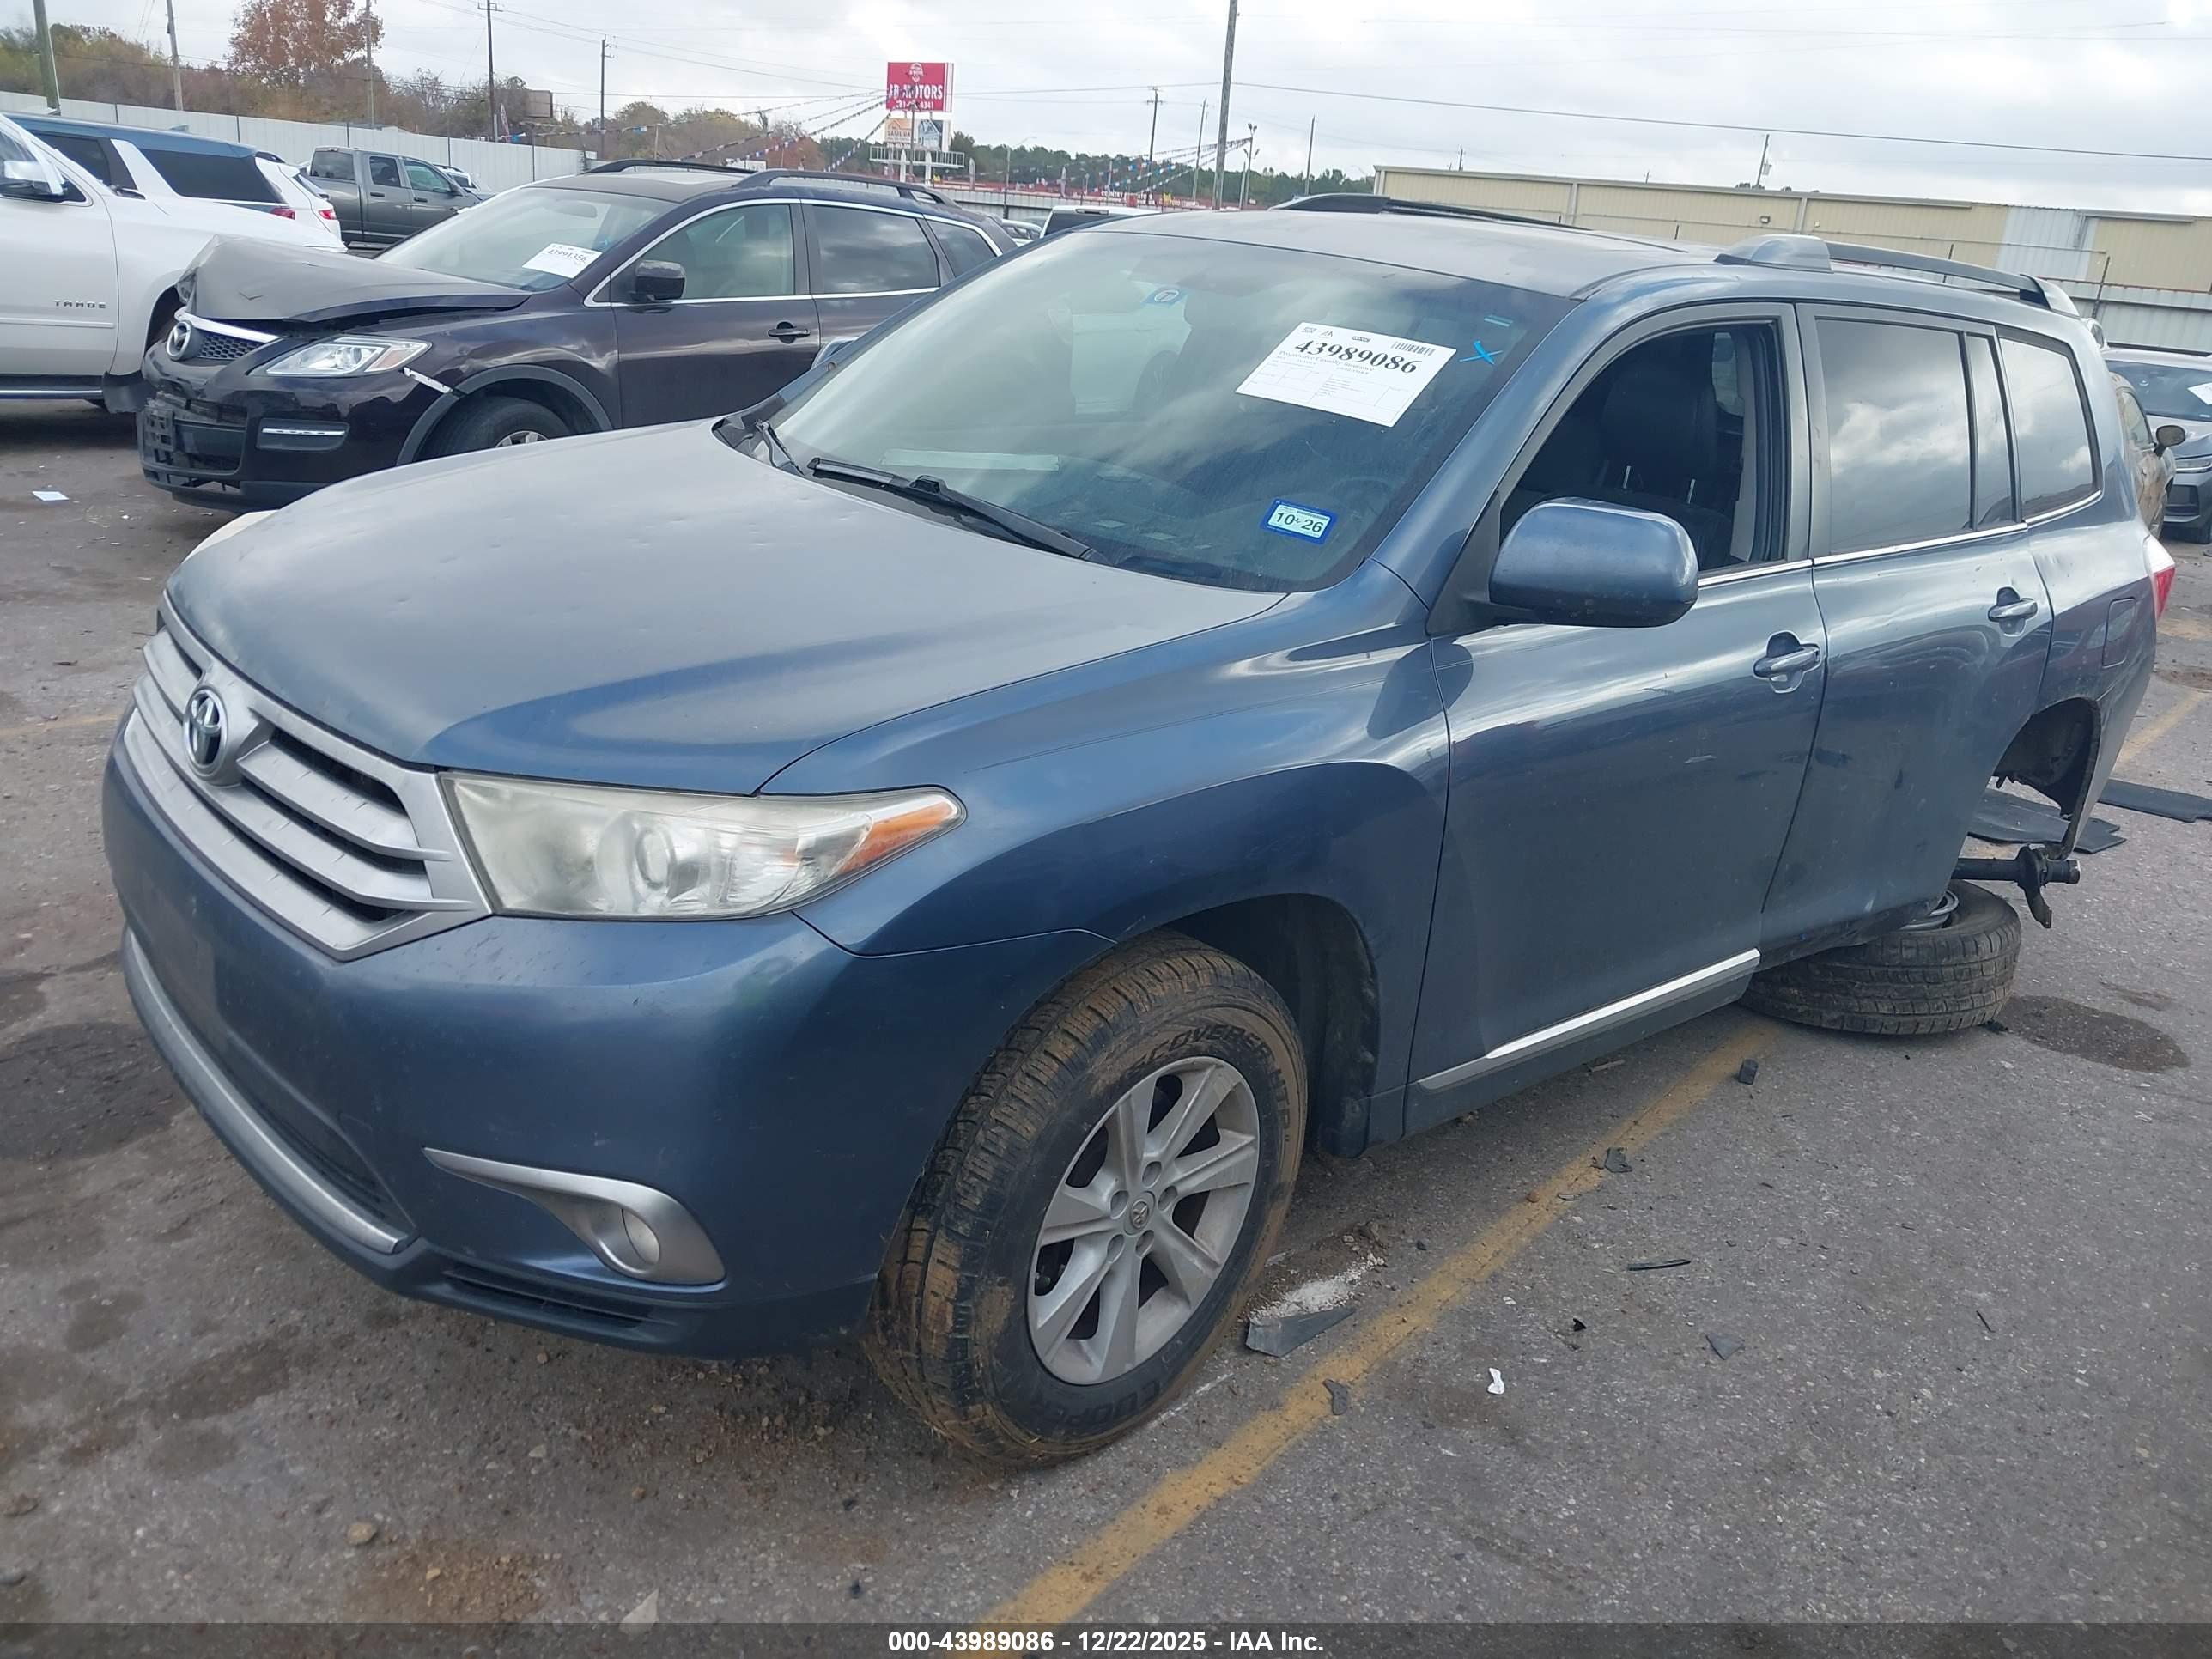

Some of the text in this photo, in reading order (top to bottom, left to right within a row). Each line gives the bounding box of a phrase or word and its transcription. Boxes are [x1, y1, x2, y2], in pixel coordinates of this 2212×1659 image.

[54, 299, 106, 309] TAHOE
[1294, 340, 1422, 374] 43989086
[1277, 512, 1296, 526] 10
[1301, 519, 1324, 532] 26
